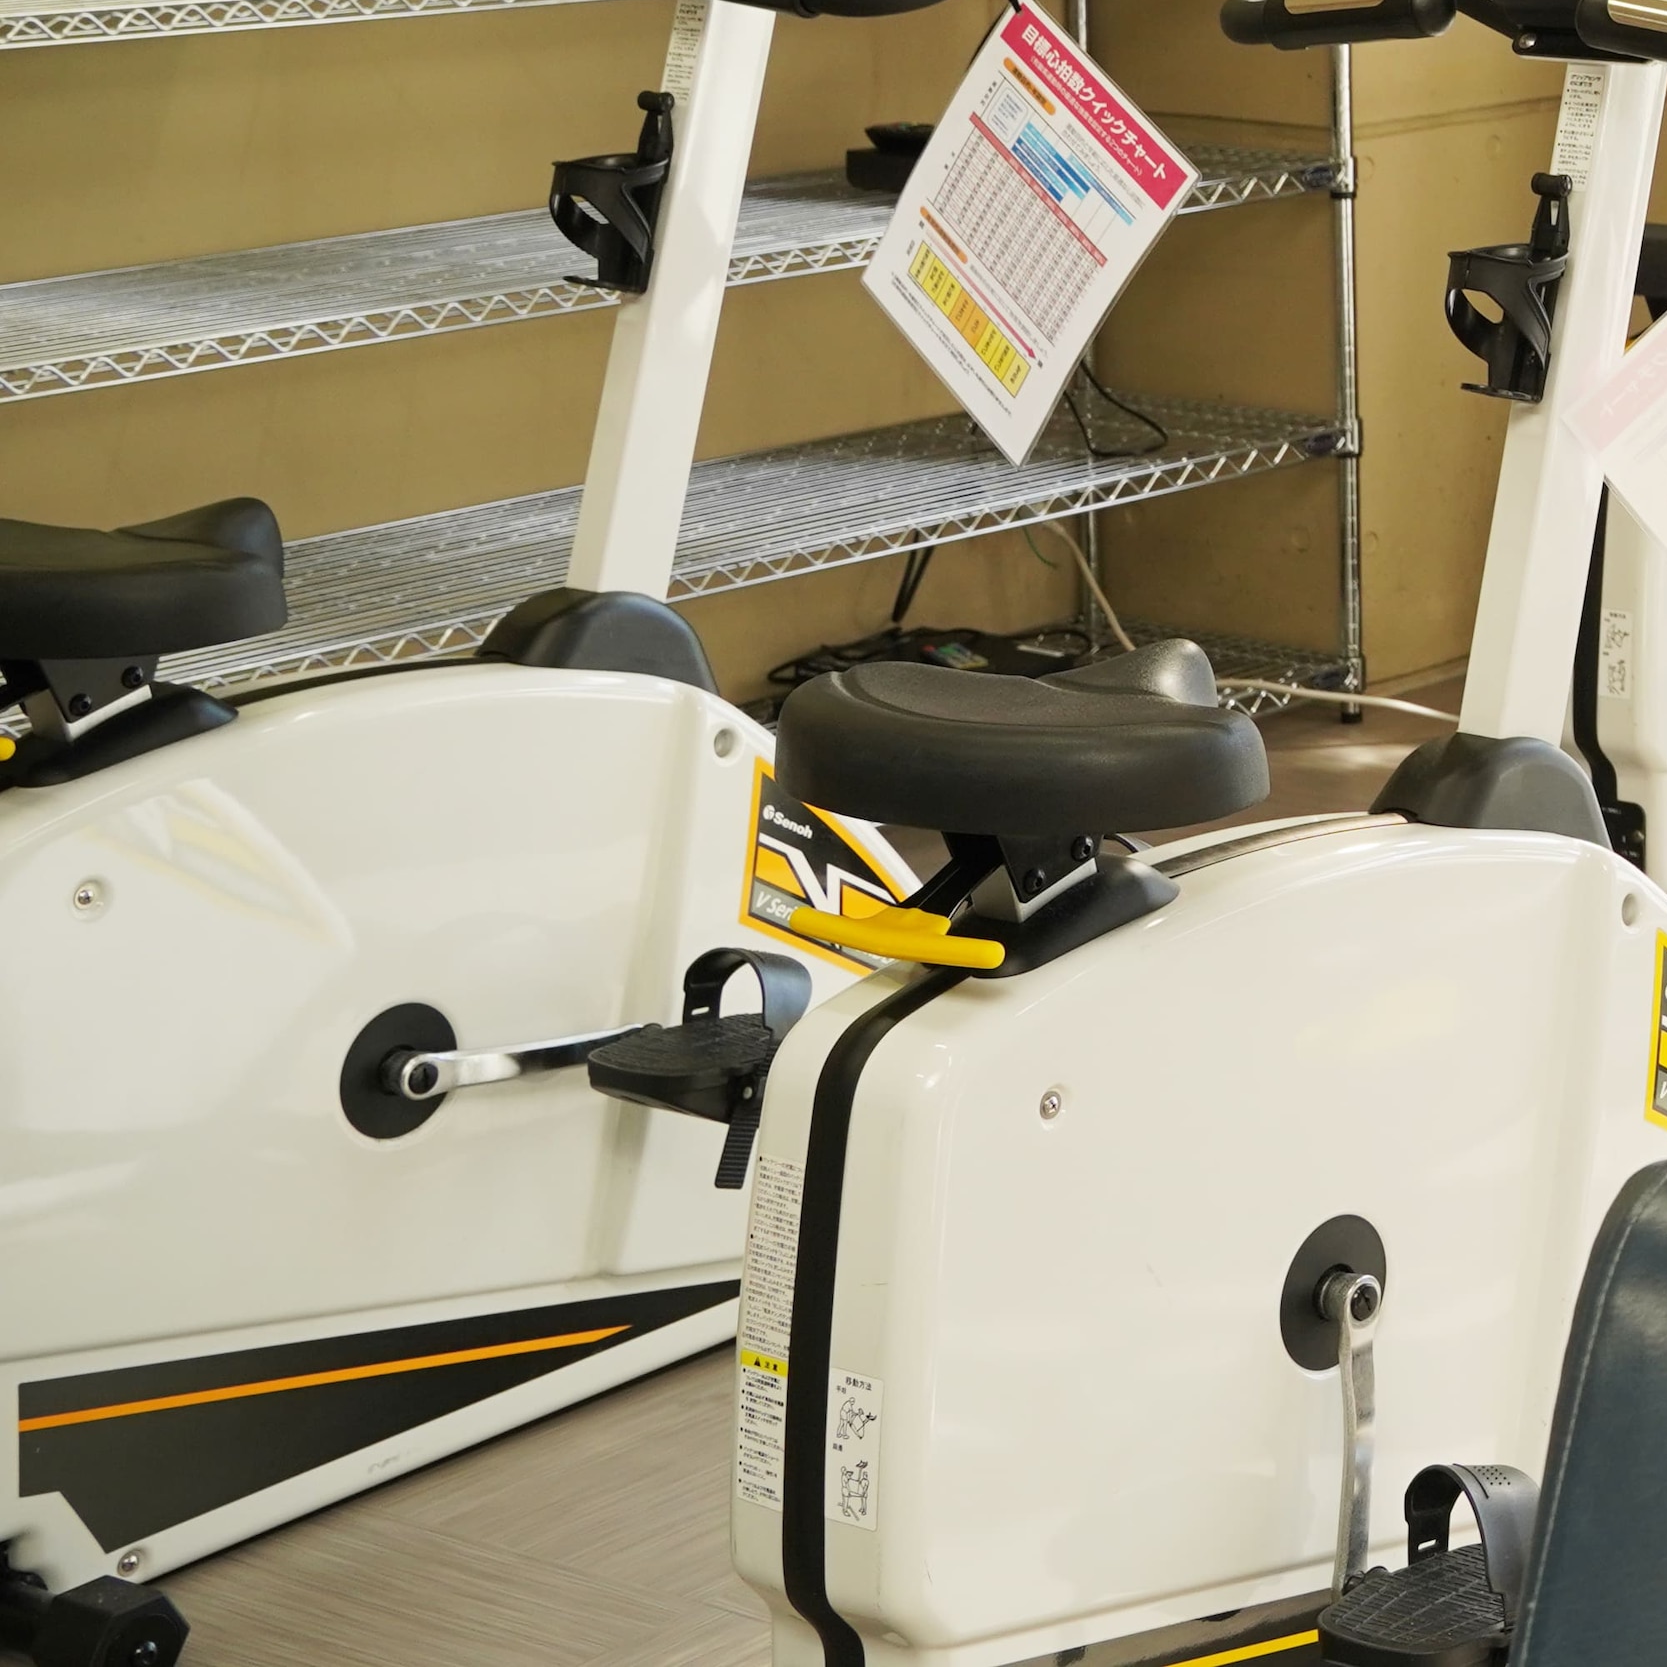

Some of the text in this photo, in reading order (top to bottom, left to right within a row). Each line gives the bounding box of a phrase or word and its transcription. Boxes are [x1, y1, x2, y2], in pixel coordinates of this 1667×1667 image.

[1021, 24, 1167, 180] 目標心拍数クイックチャート
[774, 813, 813, 840] Senoh
[844, 1376, 873, 1391] 移動方法
